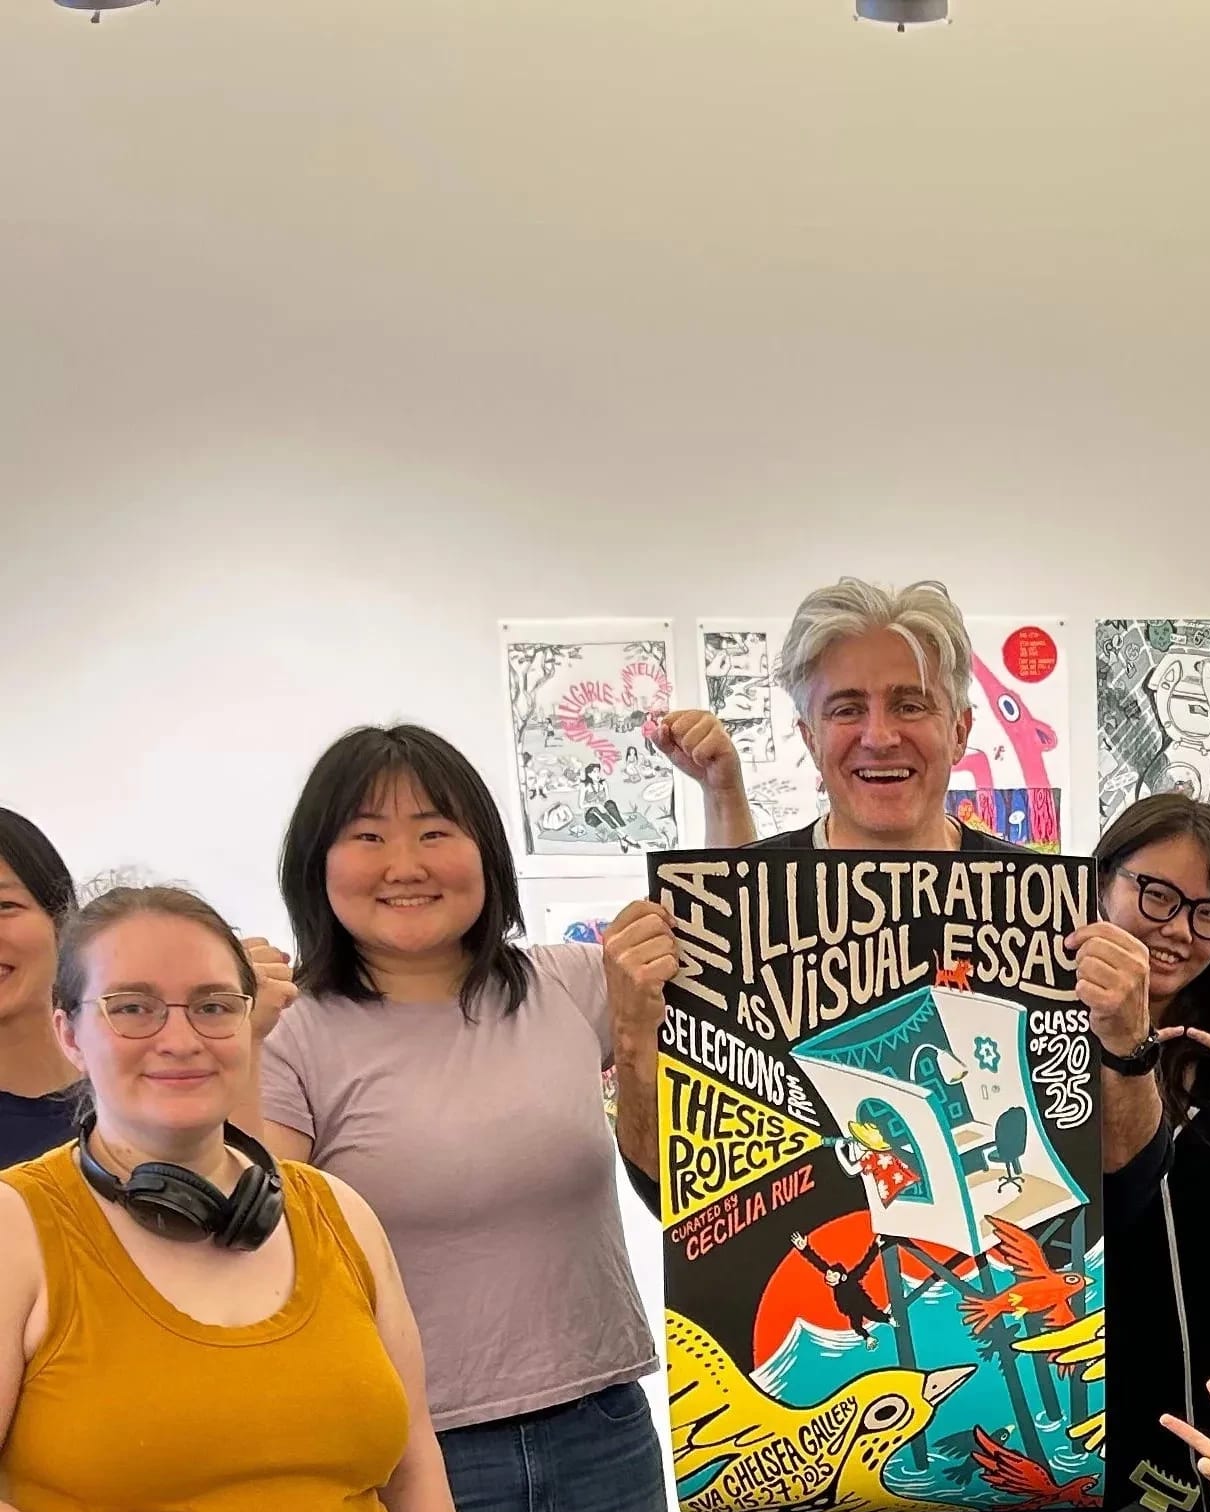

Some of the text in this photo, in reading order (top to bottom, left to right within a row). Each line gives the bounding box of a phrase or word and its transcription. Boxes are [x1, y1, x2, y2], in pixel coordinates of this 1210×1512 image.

[656, 861, 733, 1011] MFA
[737, 991, 775, 1041] AS
[1029, 1010, 1090, 1034] CLASS
[1029, 1036, 1049, 1055] OF
[786, 1074, 821, 1127] FROM
[671, 1204, 721, 1243] CURATED
[686, 1163, 816, 1261] CECILIA RUIZ
[722, 1437, 808, 1498] CHELSEA
[798, 1395, 858, 1456] GALLERY
[791, 1453, 834, 1496] 2025
